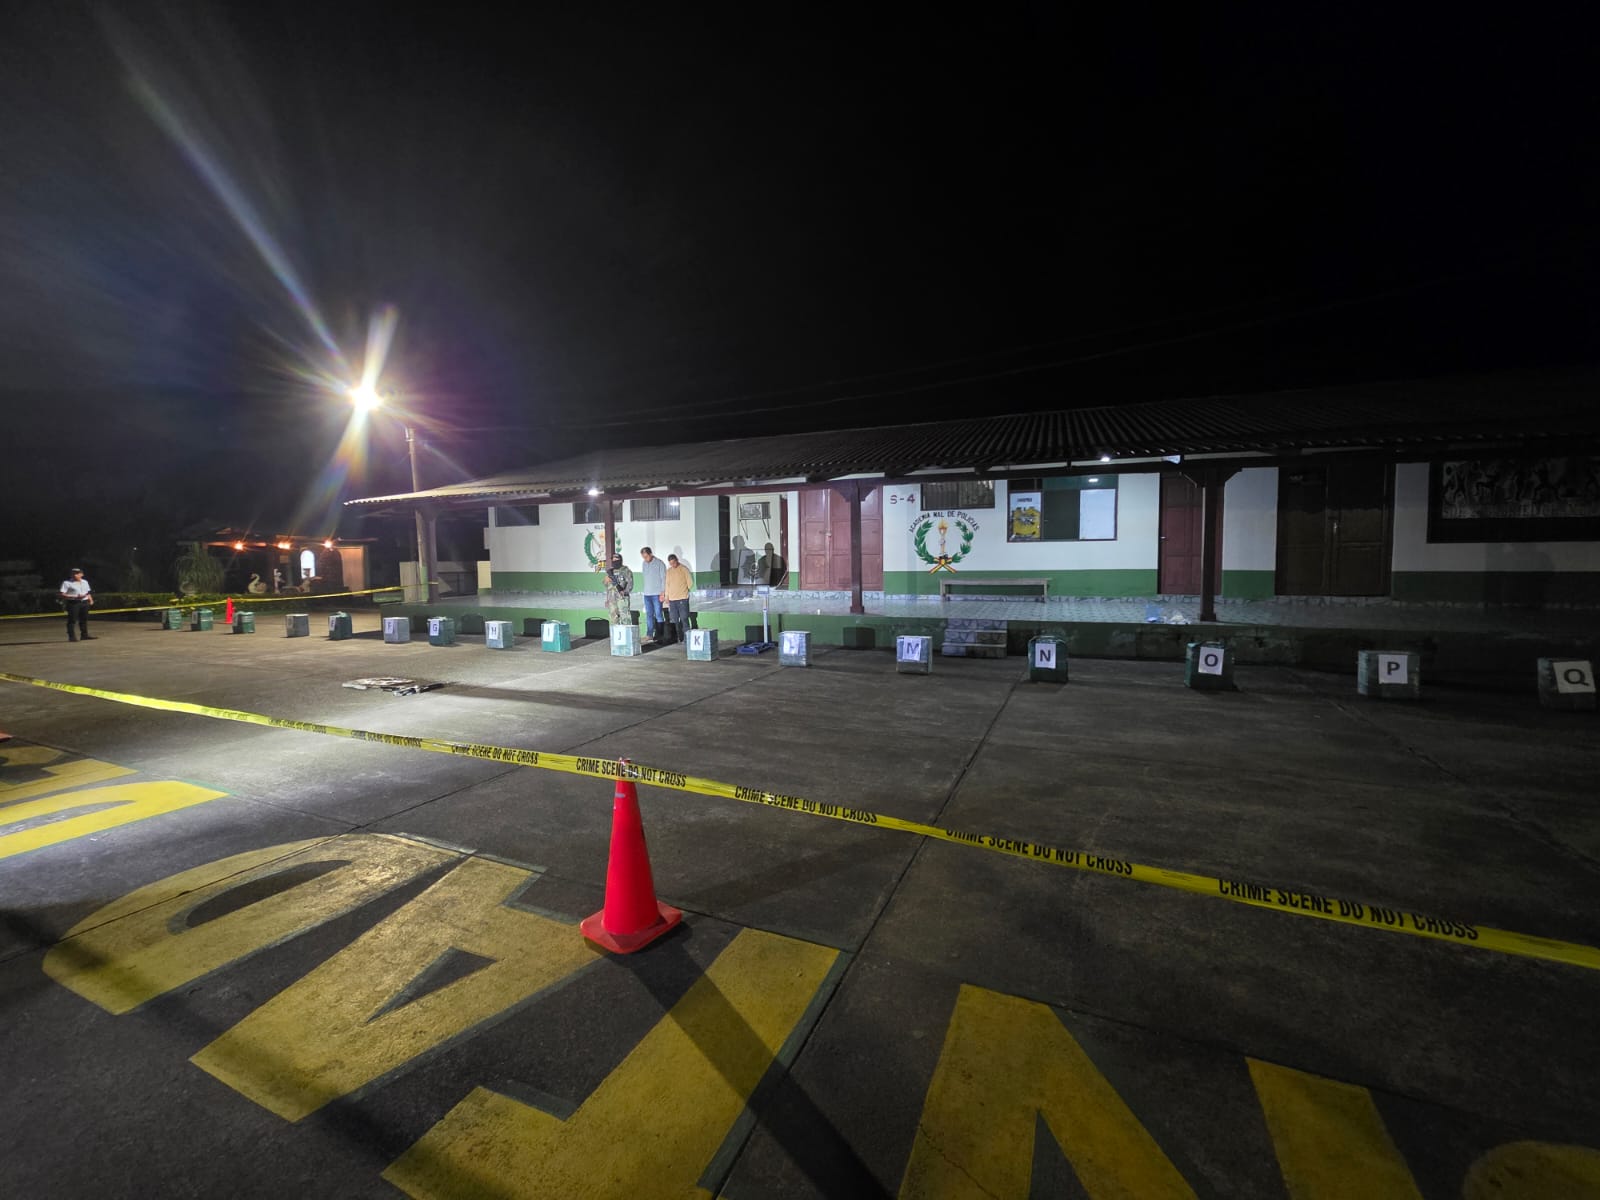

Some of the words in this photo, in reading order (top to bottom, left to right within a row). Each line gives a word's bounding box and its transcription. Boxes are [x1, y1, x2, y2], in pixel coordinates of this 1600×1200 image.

[889, 493, 916, 505] S-4
[947, 510, 956, 518] DE
[693, 636, 702, 646] K
[906, 642, 920, 654] M
[1039, 649, 1052, 662] N
[1204, 653, 1219, 667] O
[1387, 661, 1401, 676] P
[1563, 667, 1590, 686] Q
[517, 750, 539, 765] CROSS
[575, 757, 600, 773] CRIME
[601, 759, 626, 777] SCENE
[641, 767, 658, 782] NOT
[659, 770, 687, 788] CROSS
[734, 785, 766, 803] CRIME
[819, 801, 838, 816] NOT
[842, 806, 878, 824] CROSS
[1218, 879, 1273, 903] CRIME
[1277, 889, 1334, 915] SCENE
